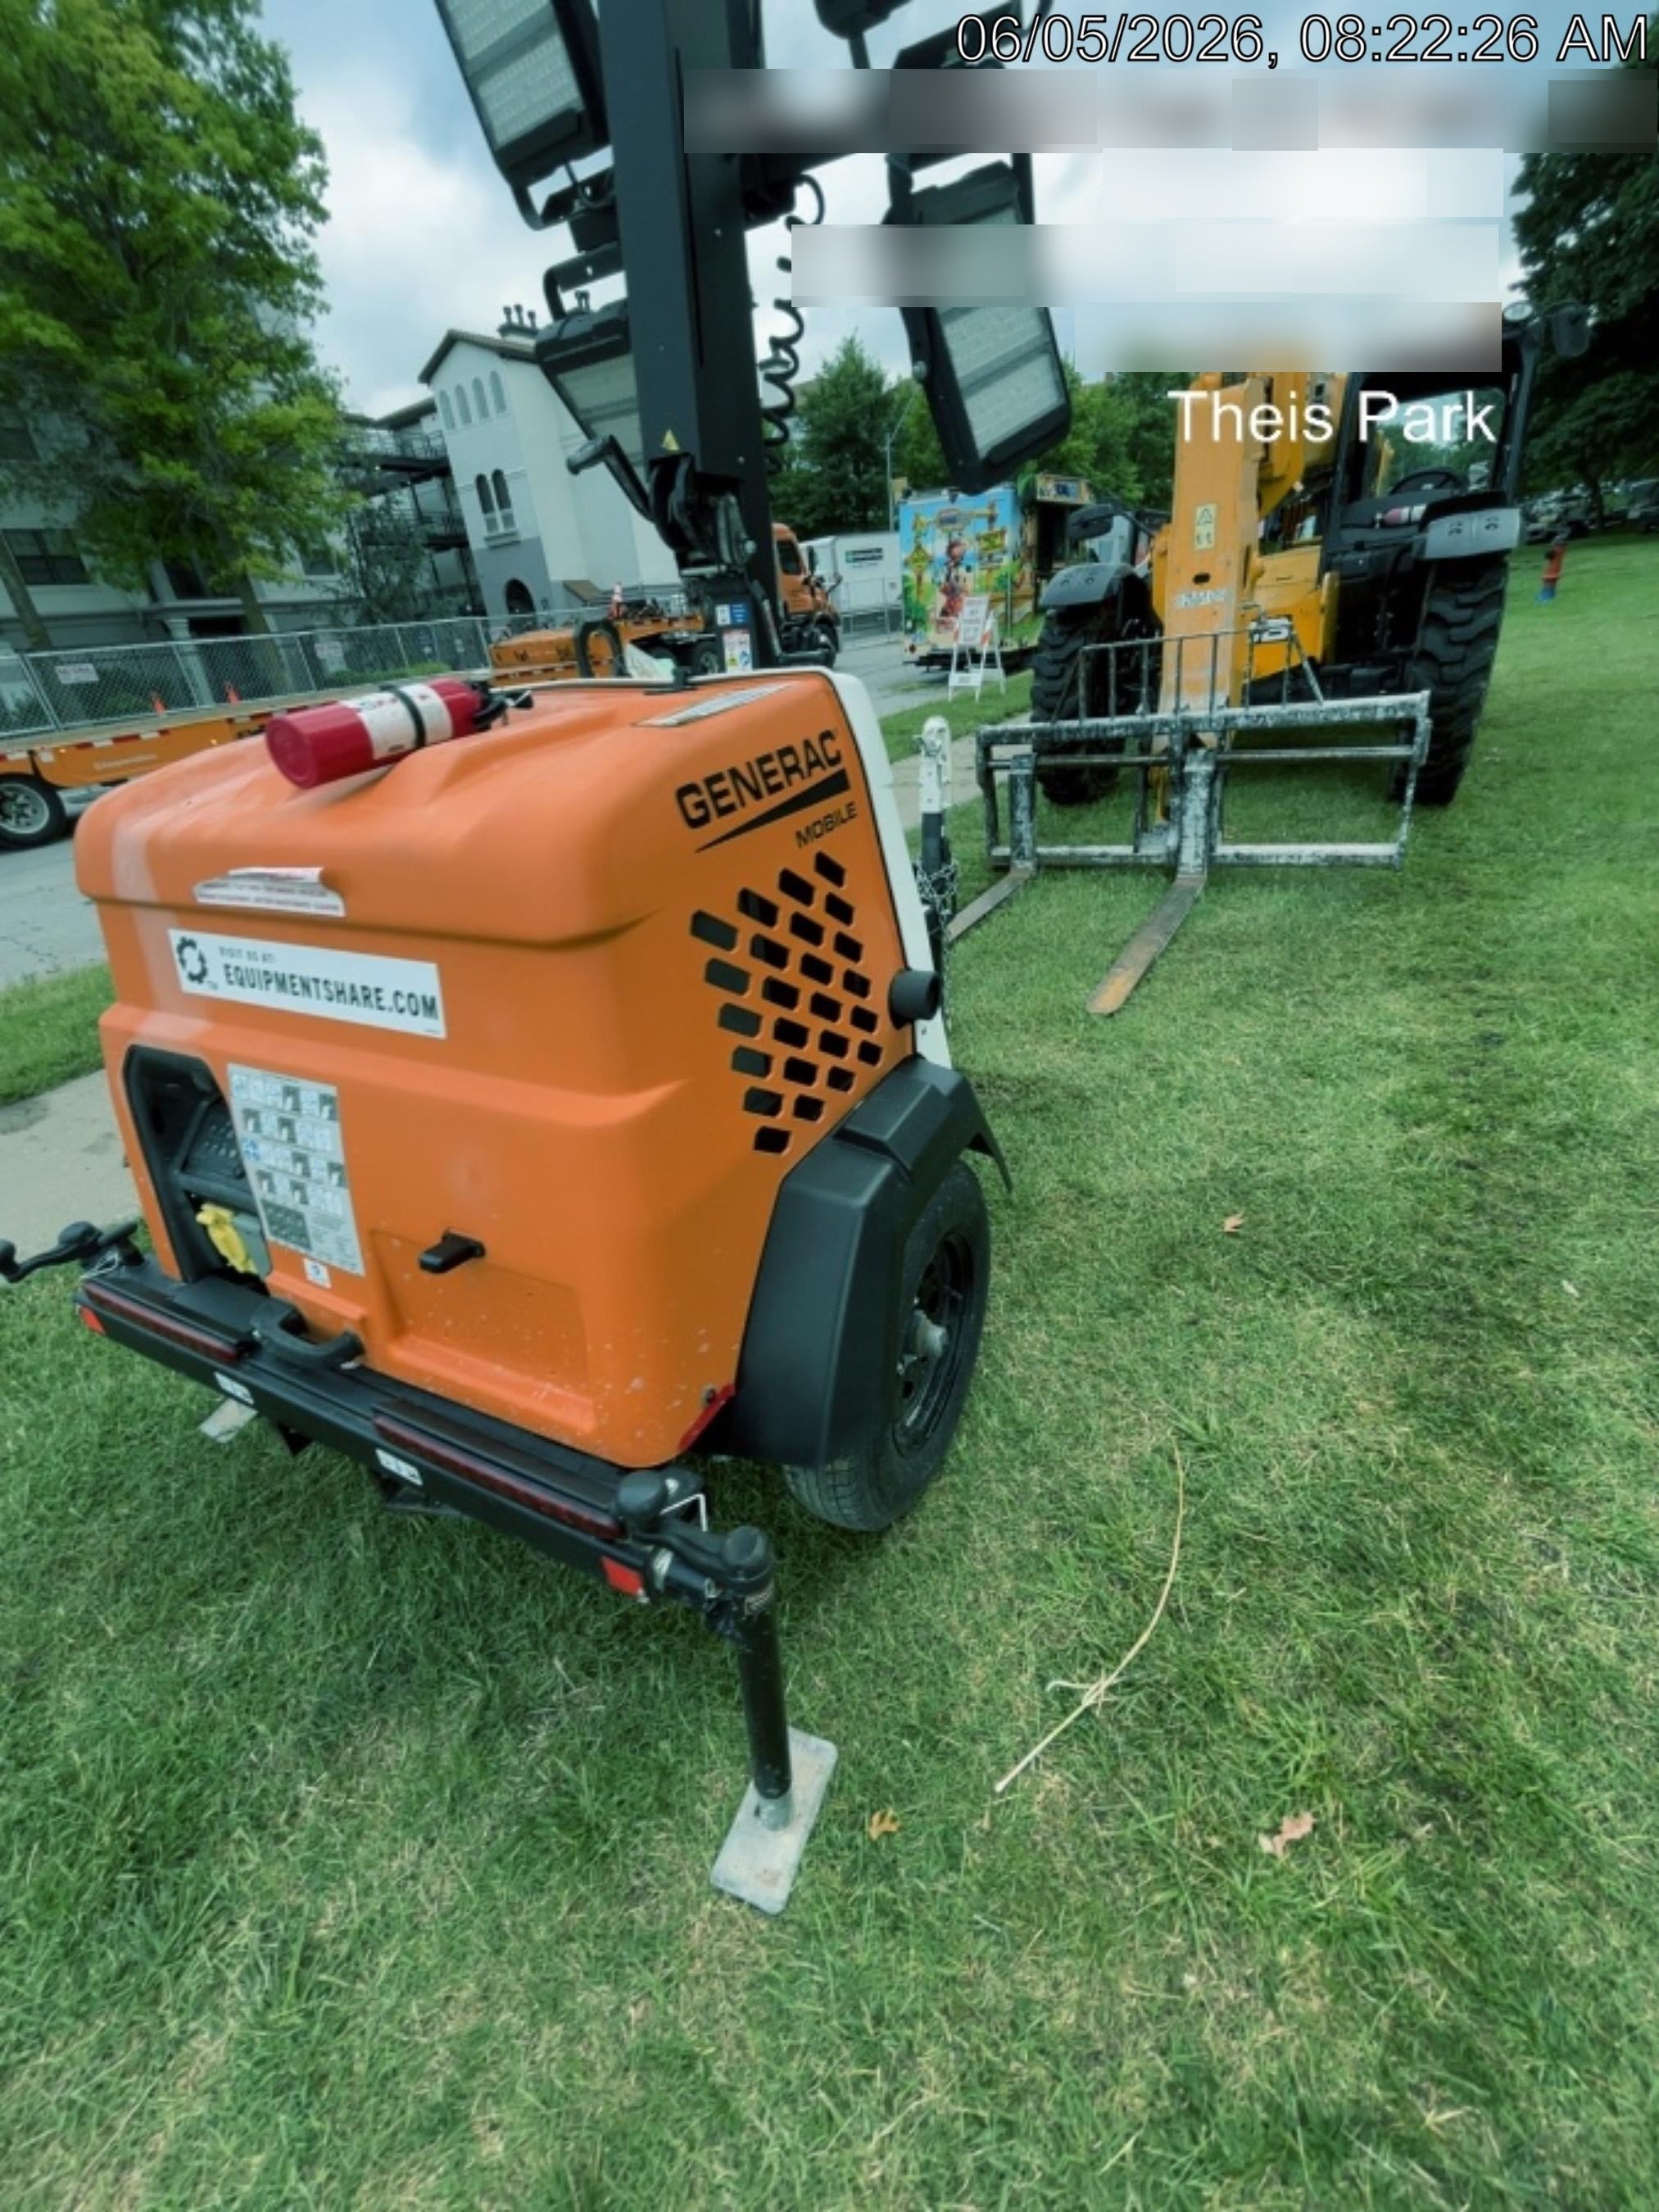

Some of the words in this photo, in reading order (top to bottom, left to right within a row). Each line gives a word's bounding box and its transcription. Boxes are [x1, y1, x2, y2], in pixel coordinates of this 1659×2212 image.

[675, 729, 842, 830] GENERAC
[796, 800, 858, 848] MOBILE
[224, 963, 437, 1020] EQUIPMENTSHARE.COM
